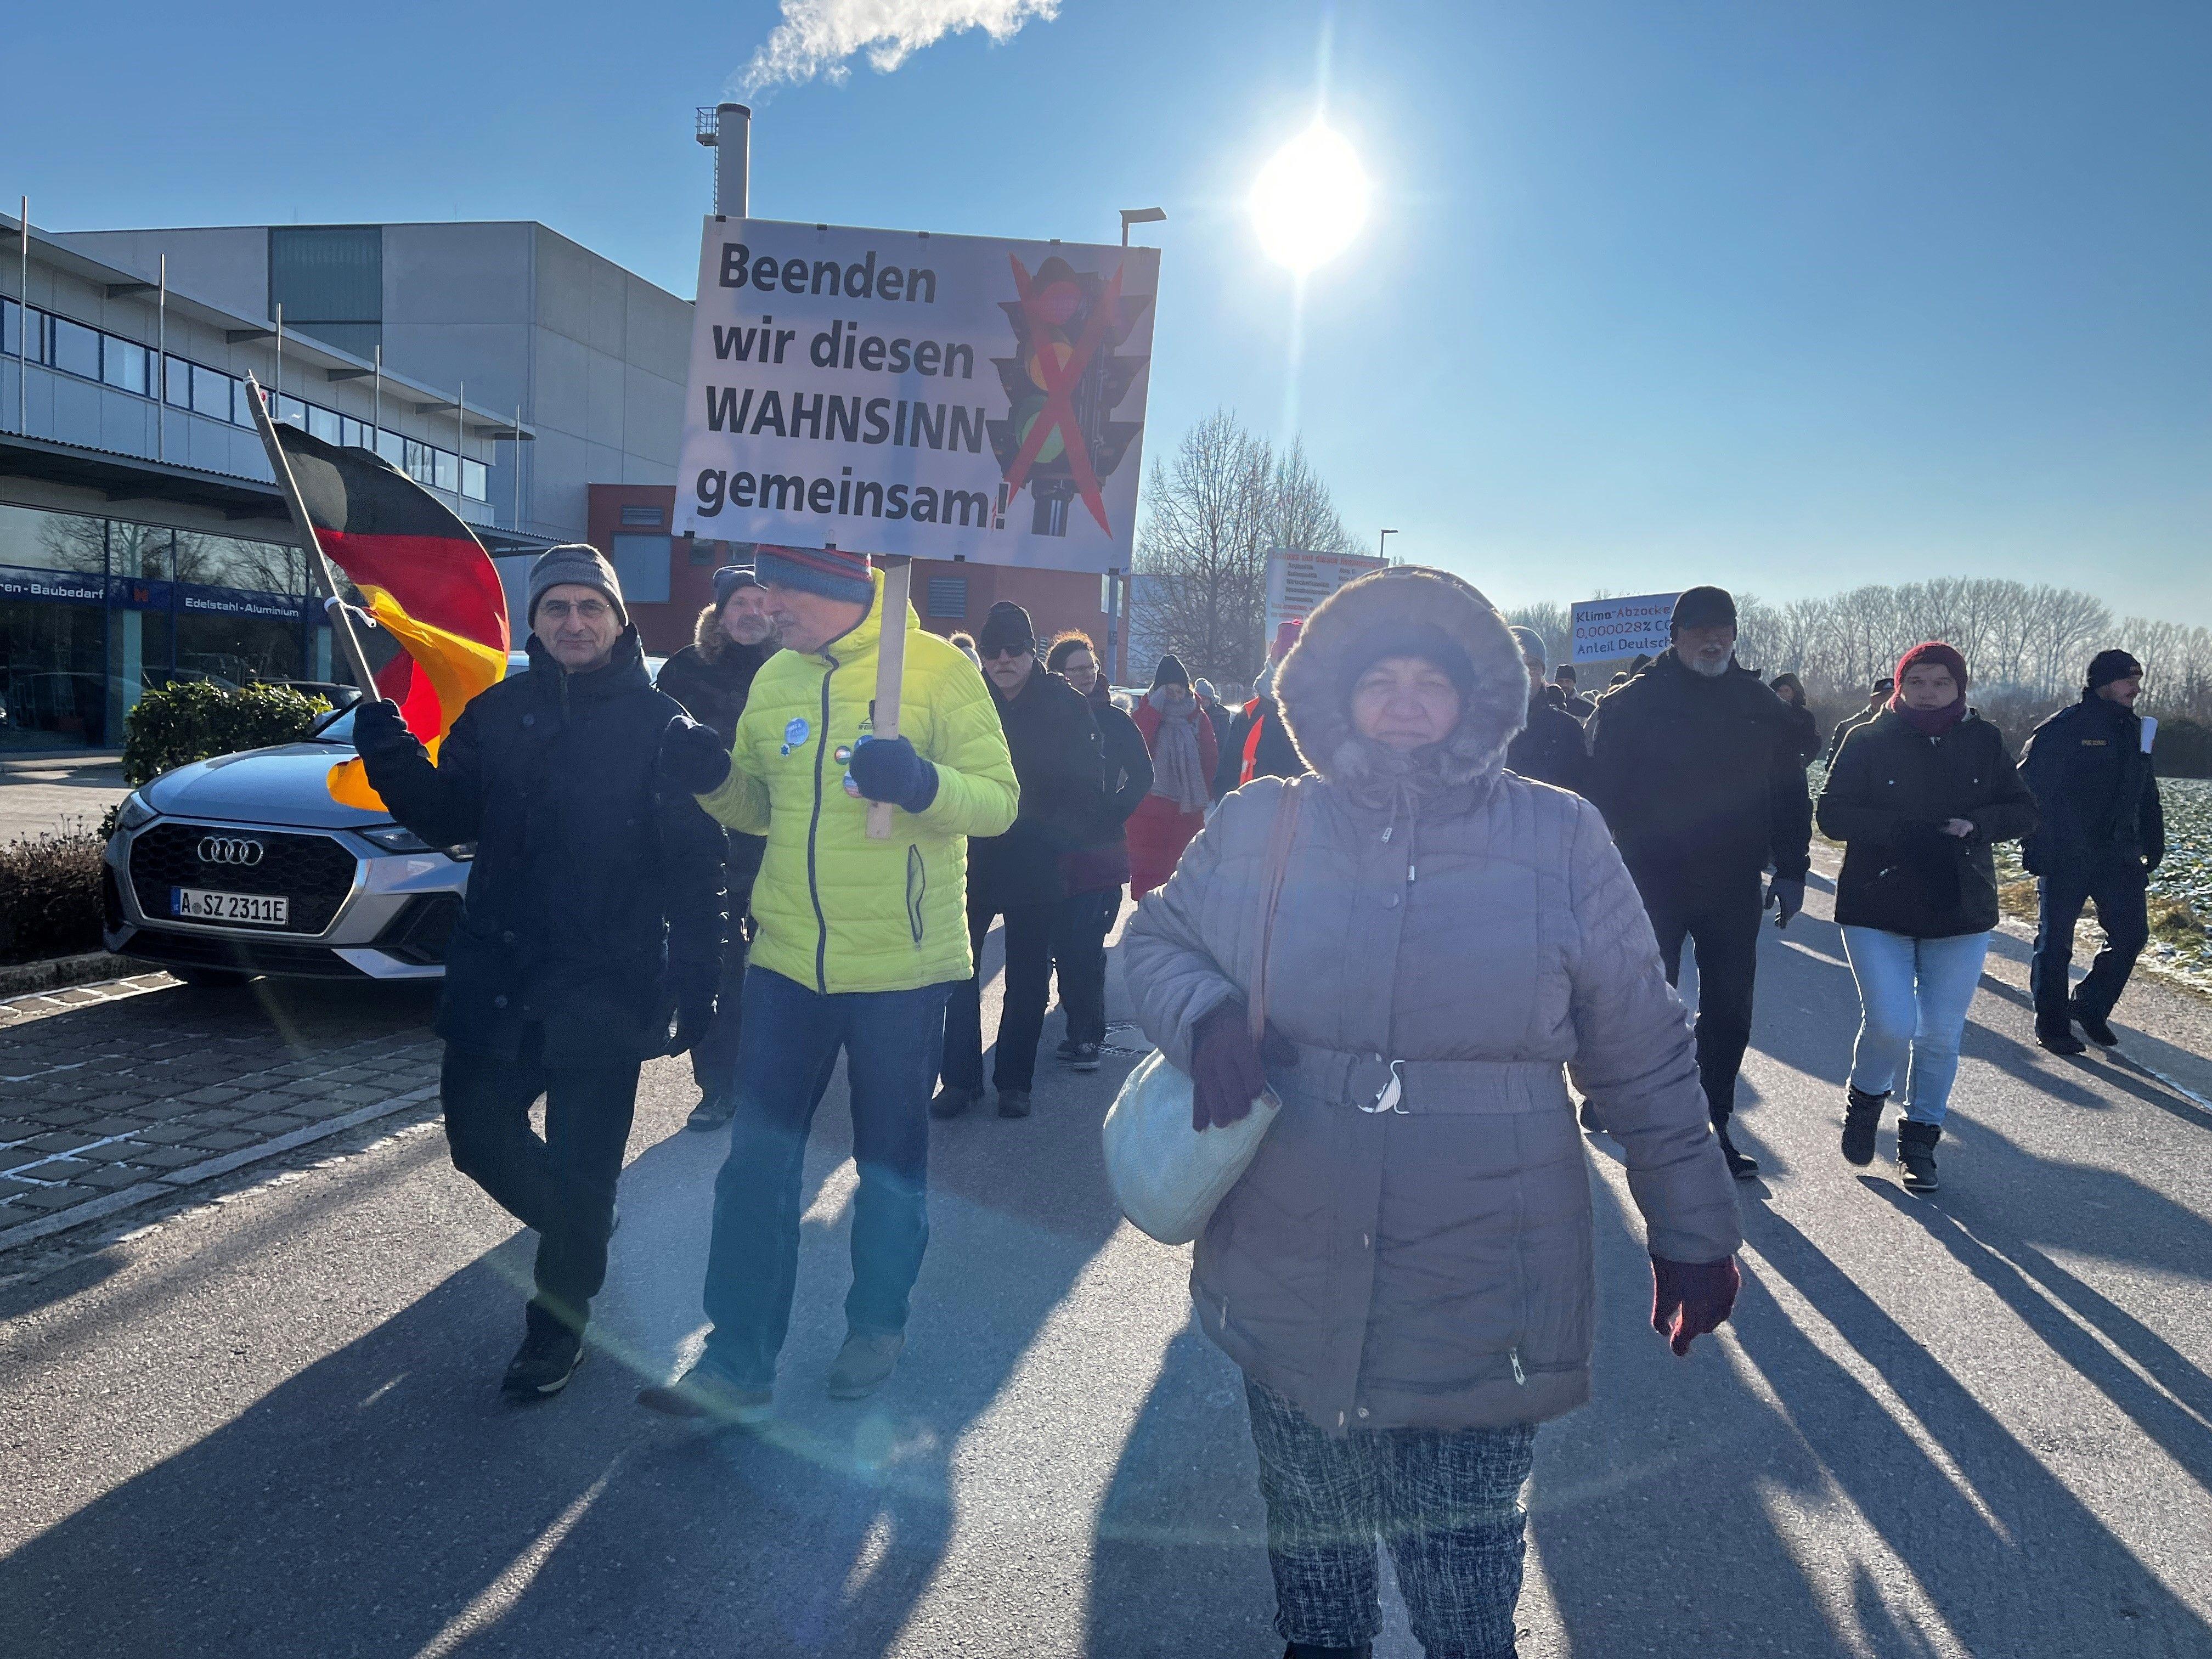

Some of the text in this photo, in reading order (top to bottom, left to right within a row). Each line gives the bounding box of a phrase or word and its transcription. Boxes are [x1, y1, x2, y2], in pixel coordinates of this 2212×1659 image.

[719, 242, 937, 304] Beenden
[712, 315, 974, 380] wir diesen
[706, 385, 985, 454] WAHNSINN
[696, 466, 1009, 531] gemeinsam!
[1577, 641, 1615, 655] Anteil
[182, 892, 286, 922] A SZ 2311E
